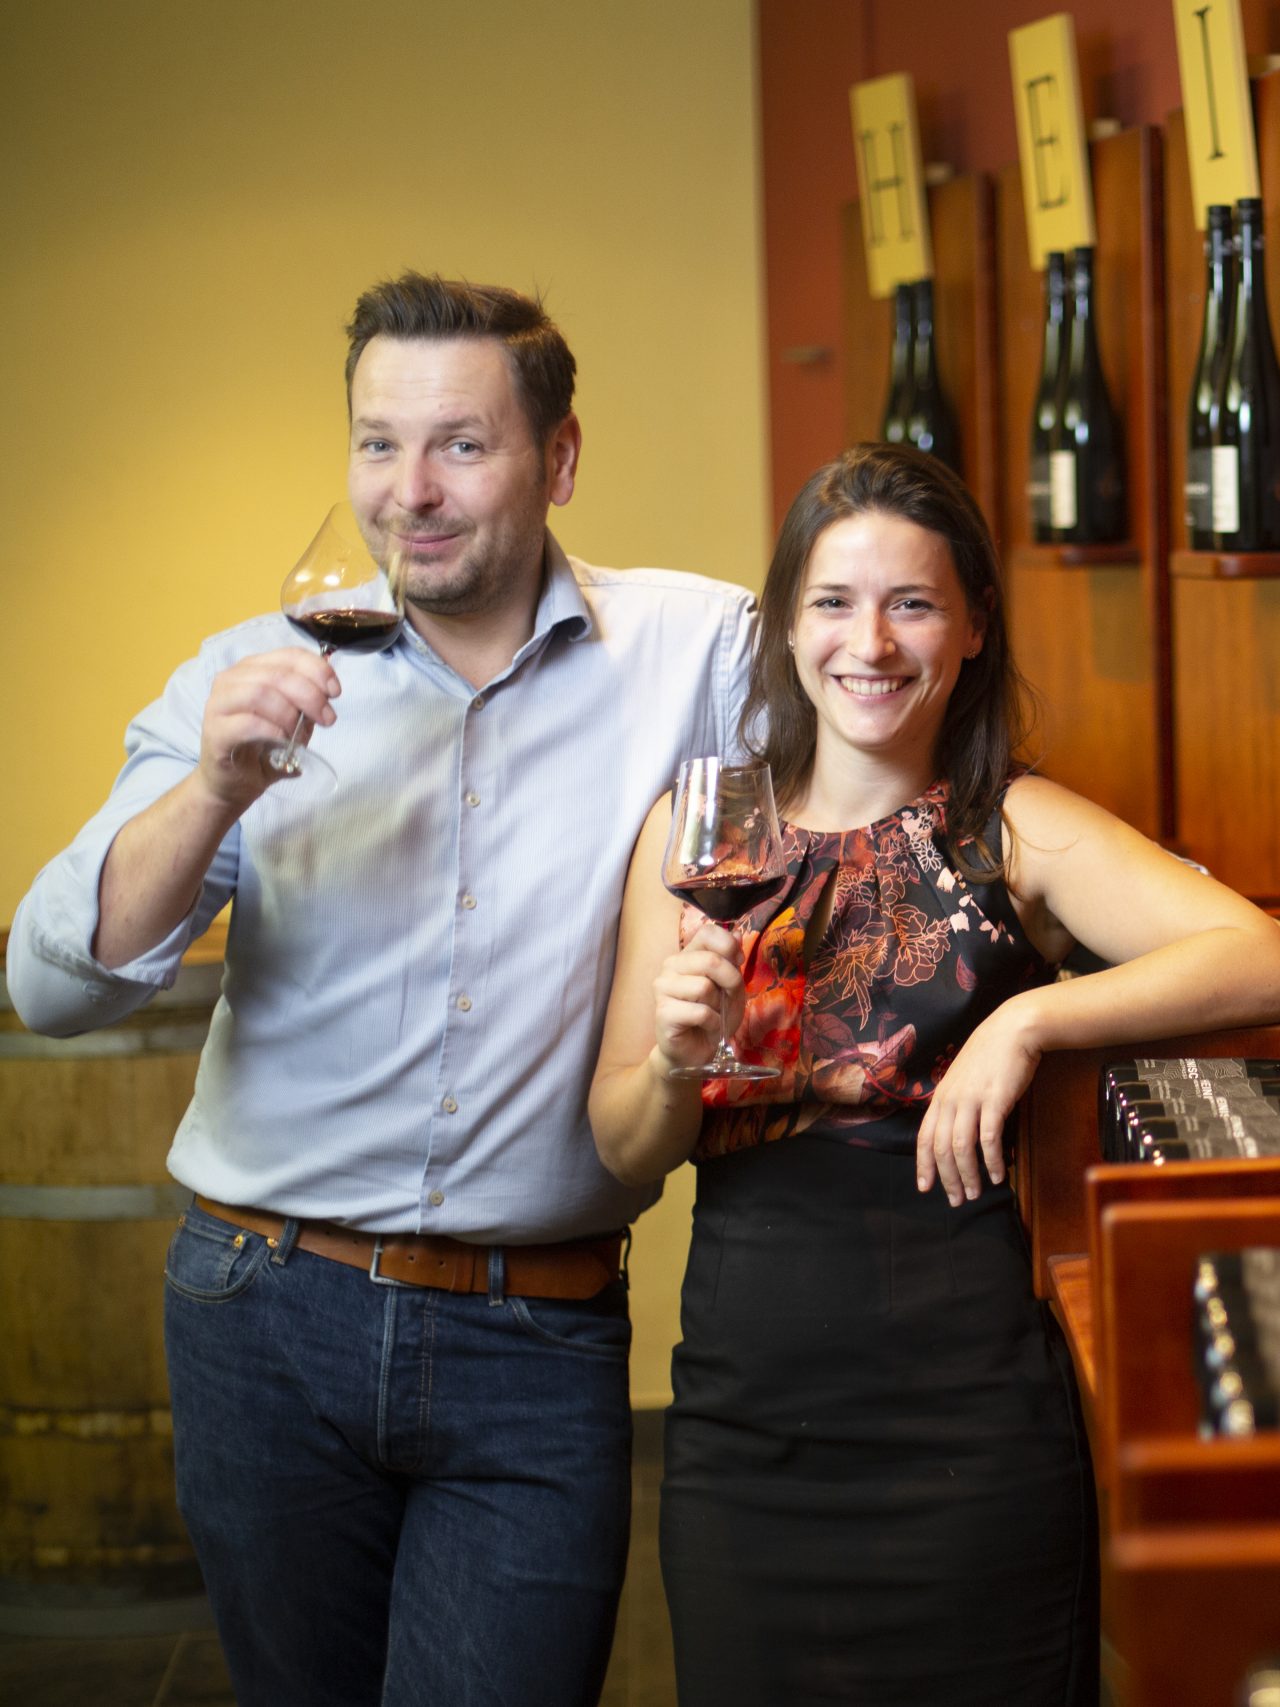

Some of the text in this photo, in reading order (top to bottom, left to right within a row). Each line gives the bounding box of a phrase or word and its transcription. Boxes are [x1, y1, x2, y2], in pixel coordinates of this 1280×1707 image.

[862, 121, 913, 245] H
[1025, 74, 1070, 210] E
[1193, 5, 1225, 162] I
